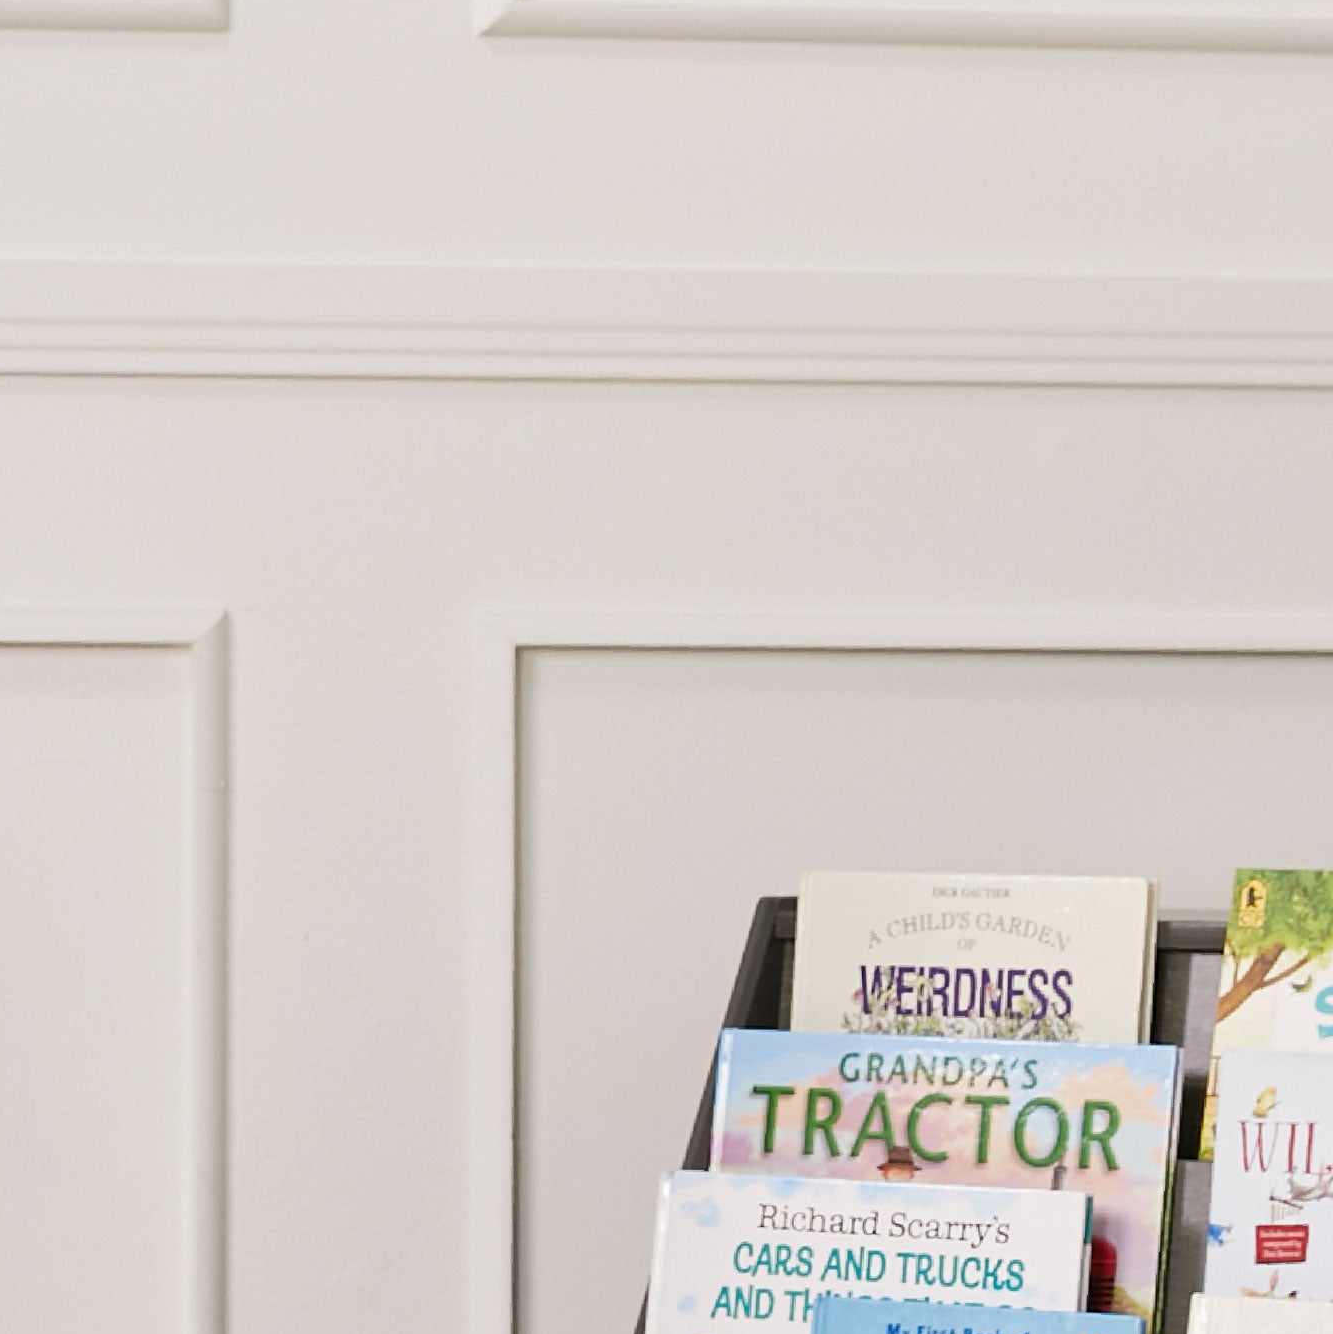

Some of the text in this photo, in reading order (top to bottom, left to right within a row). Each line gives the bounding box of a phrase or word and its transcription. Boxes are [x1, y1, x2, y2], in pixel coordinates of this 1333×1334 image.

[867, 911, 1071, 953] A CHILD'S GARDEN
[858, 964, 1074, 1021] WEIRDNESS
[837, 1051, 1039, 1091] GRANDPA'S
[751, 1083, 1123, 1172] TRACTOR
[757, 1203, 1011, 1249] Richard Scarry's
[733, 1241, 1026, 1292] CARS AND TRUCKS
[710, 1283, 776, 1320] AND
